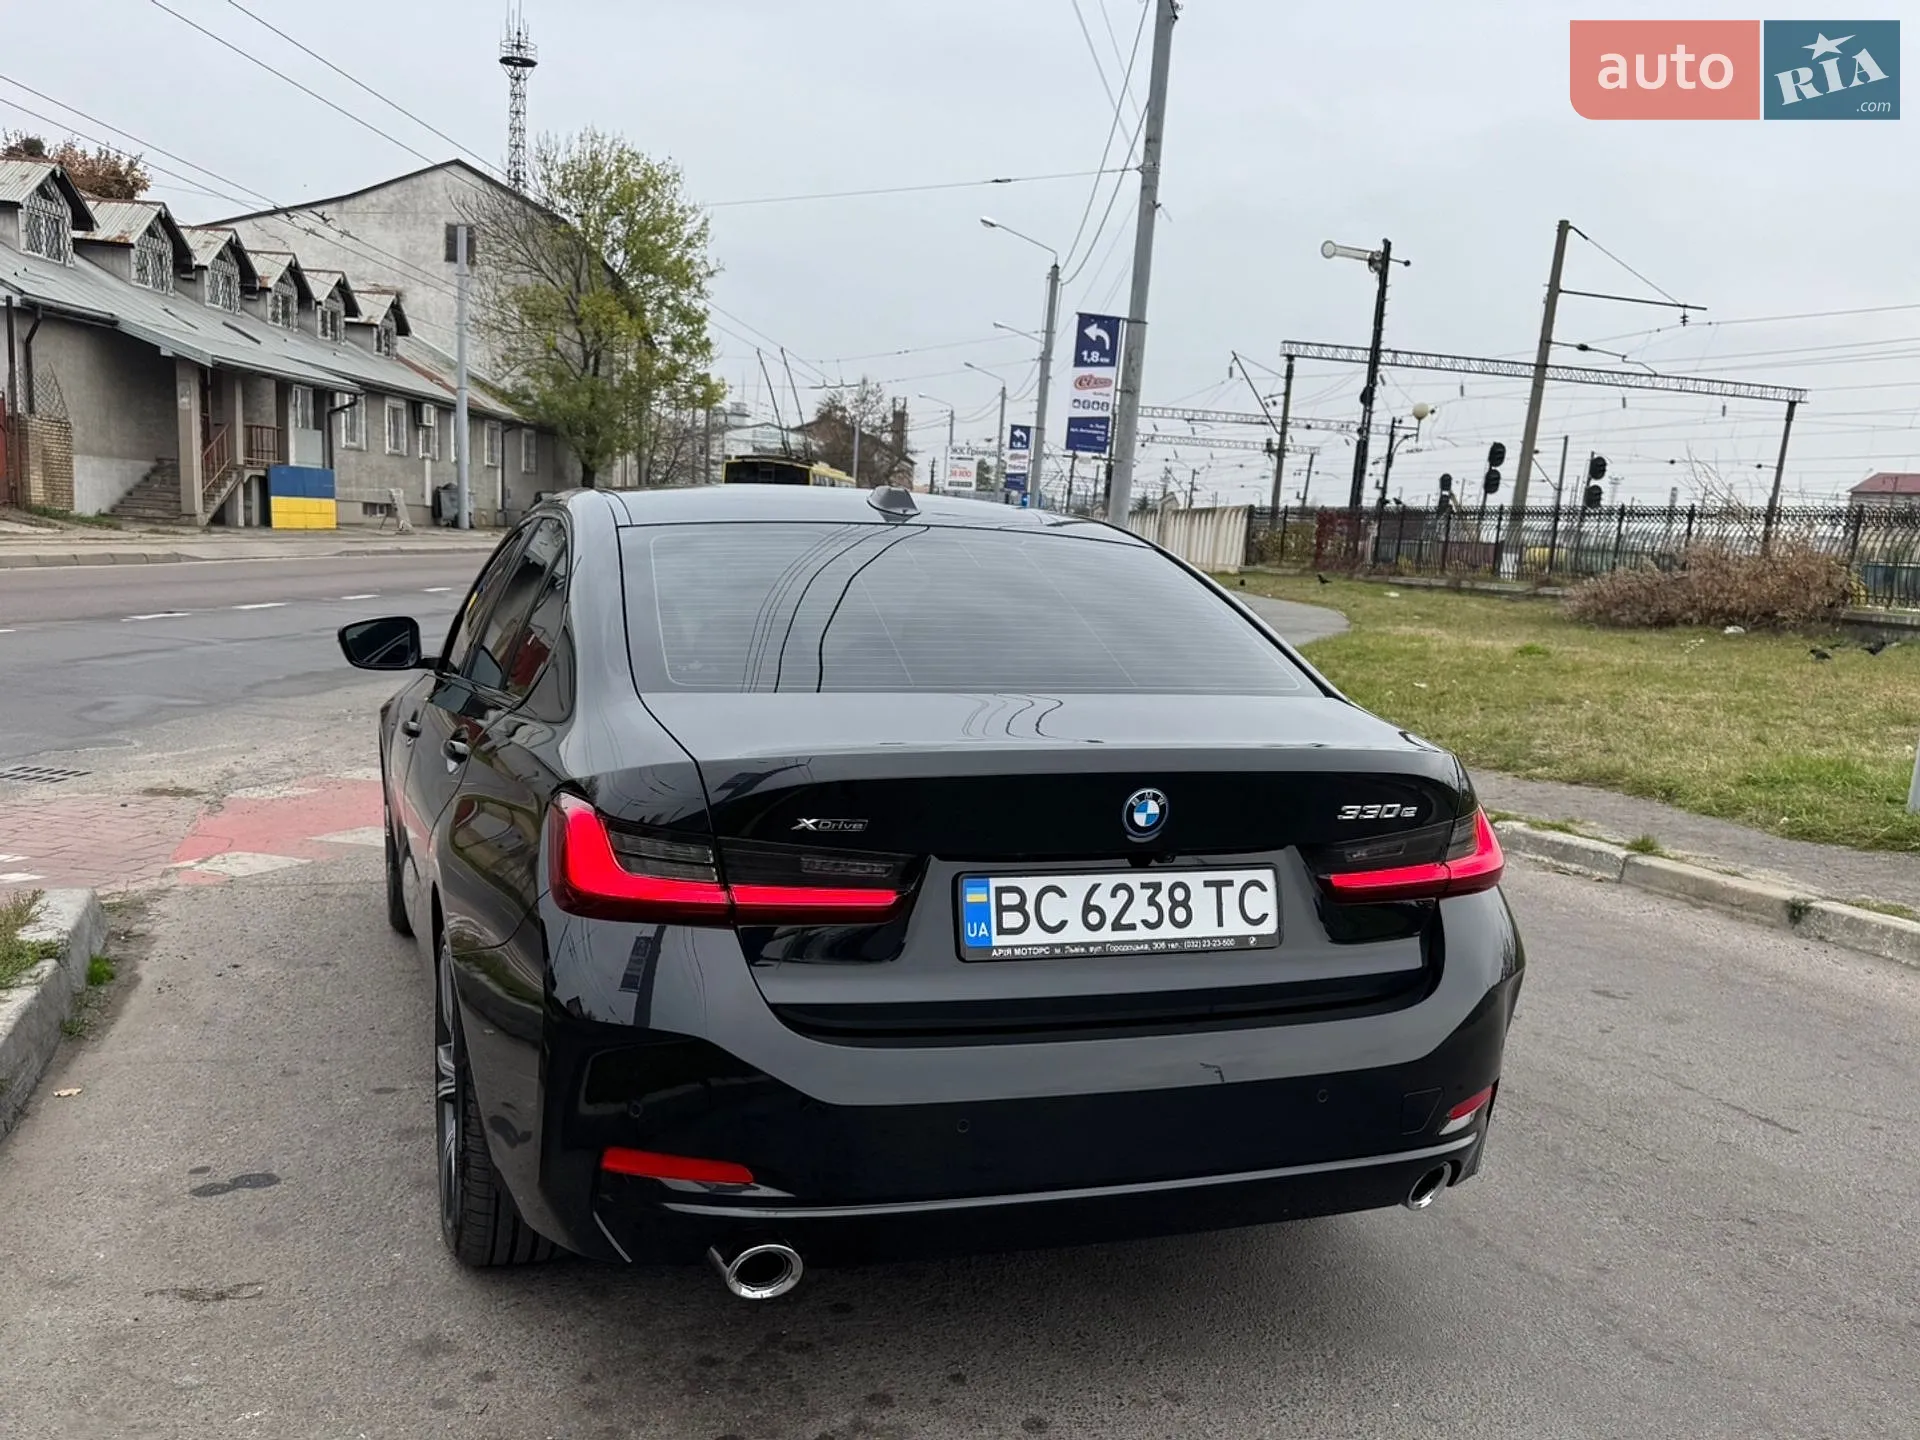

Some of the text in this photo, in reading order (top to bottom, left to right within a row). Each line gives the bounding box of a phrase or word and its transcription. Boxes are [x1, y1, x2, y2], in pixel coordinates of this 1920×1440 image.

[1337, 803, 1418, 820] 330e
[995, 879, 1269, 936] BC 6238 TC
[968, 923, 989, 938] UA
